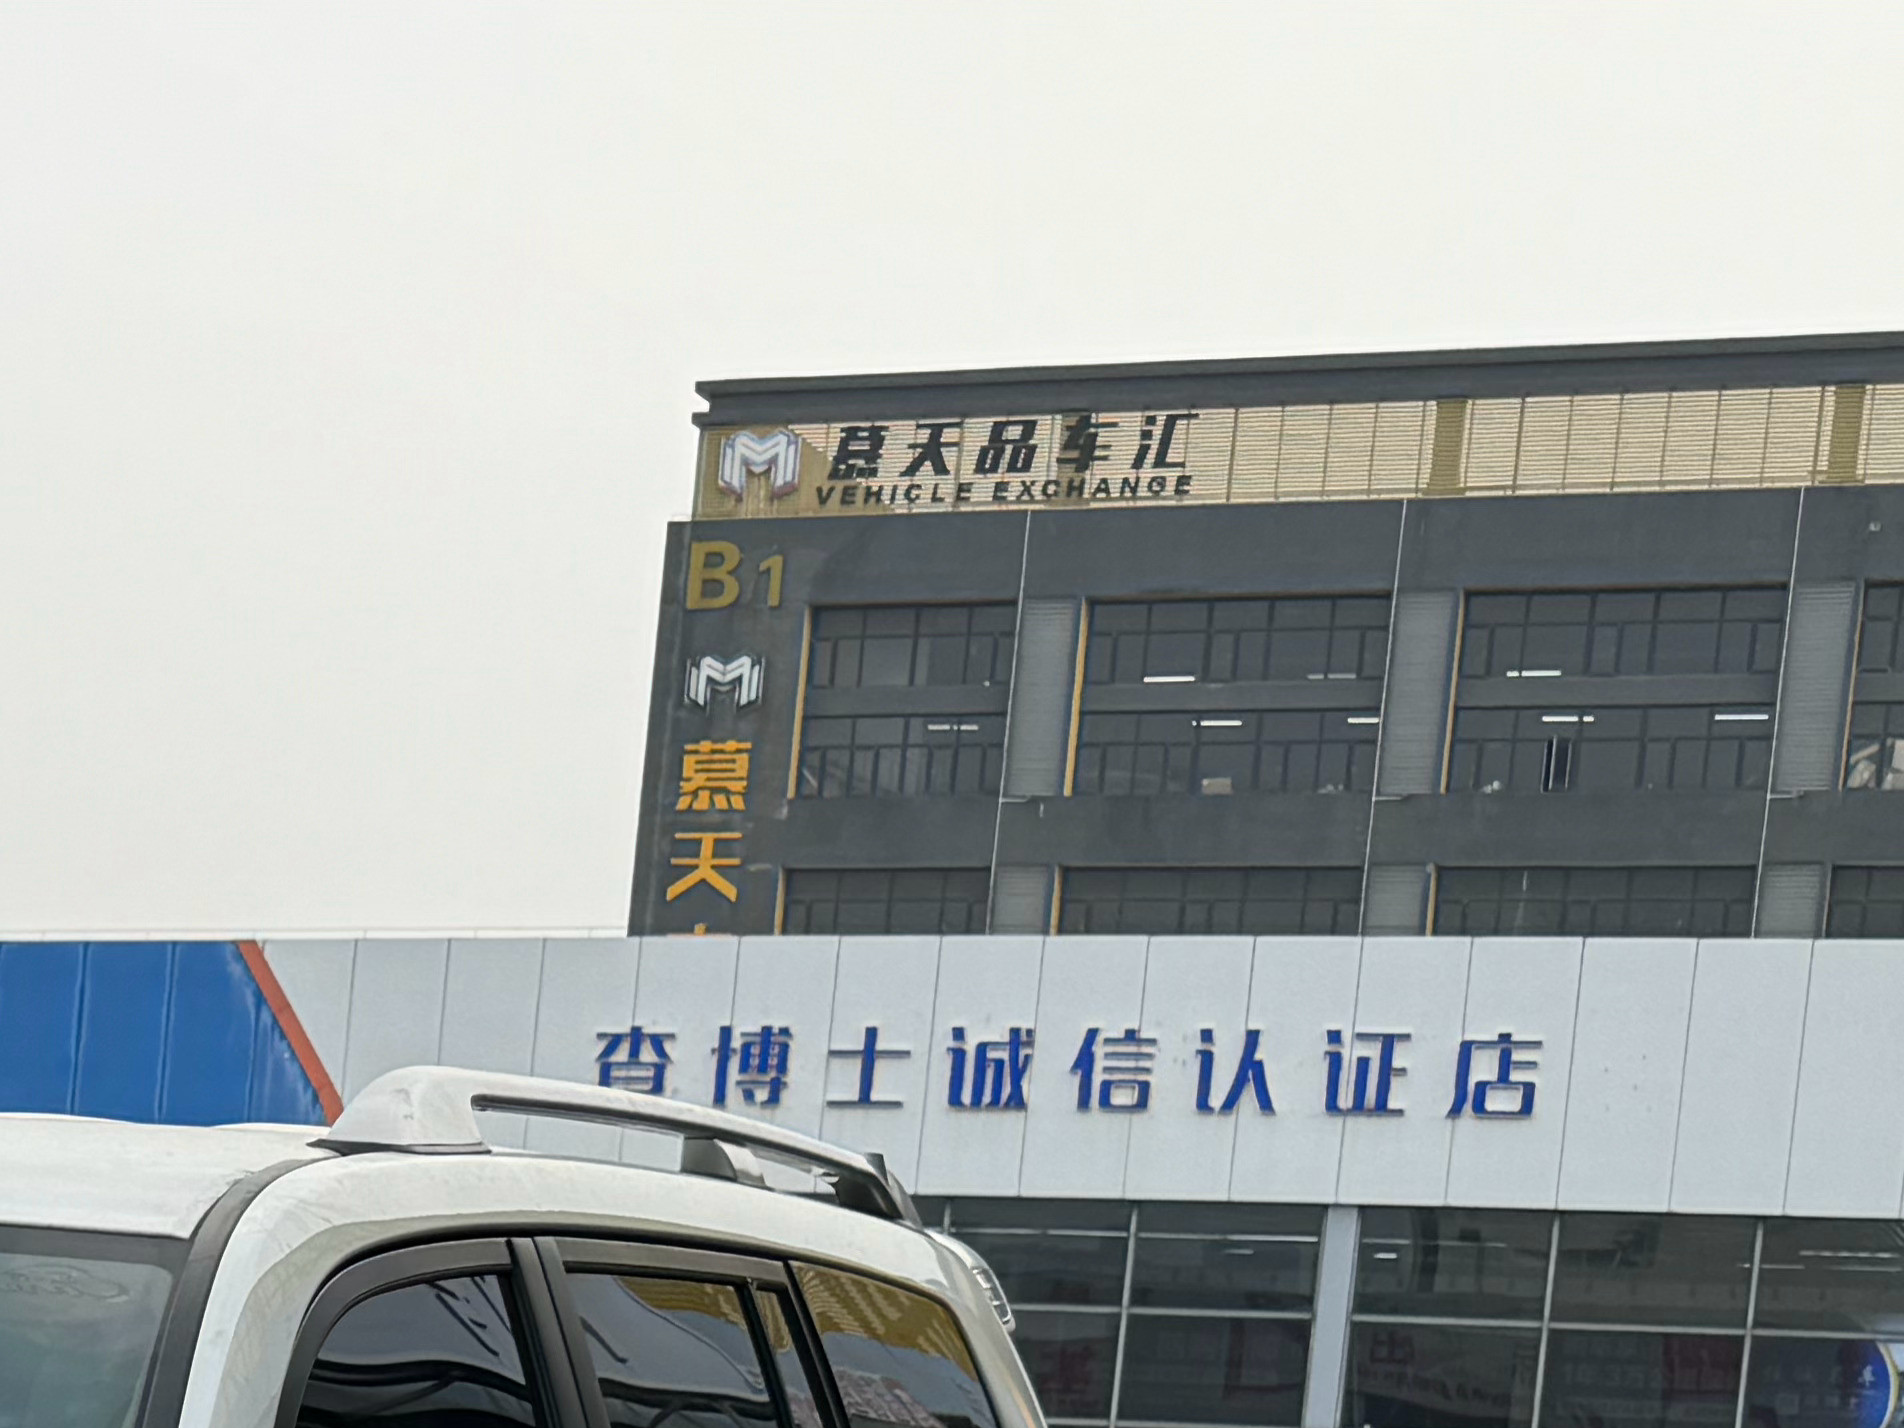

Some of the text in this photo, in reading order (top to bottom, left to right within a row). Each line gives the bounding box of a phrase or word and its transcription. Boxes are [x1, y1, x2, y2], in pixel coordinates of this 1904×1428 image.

[828, 413, 1200, 482] 慕天品车汇
[816, 474, 1194, 506] VEHICLE EXCHANGE
[685, 540, 784, 611] B1
[666, 740, 753, 934] 慕天
